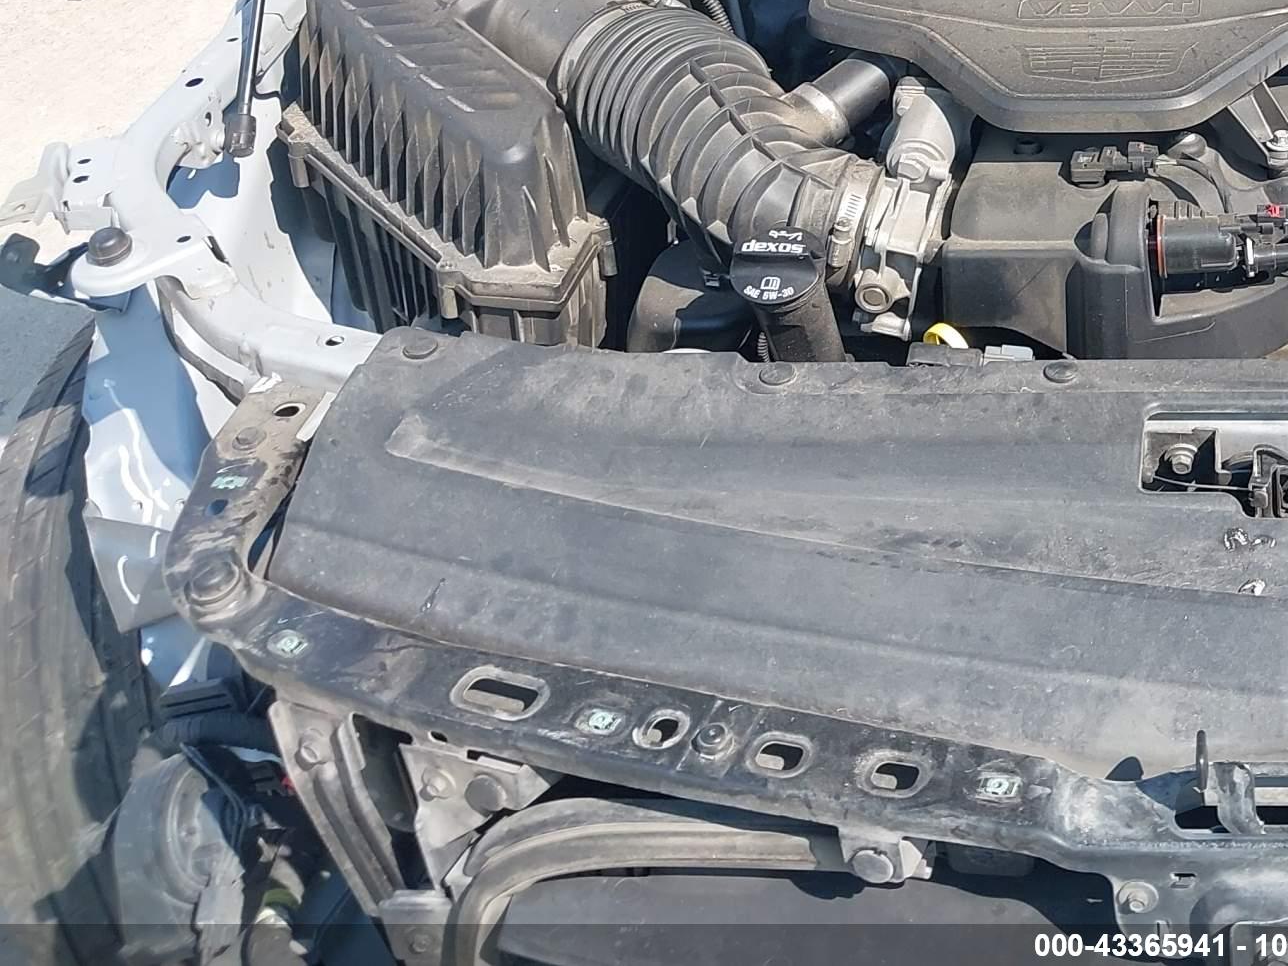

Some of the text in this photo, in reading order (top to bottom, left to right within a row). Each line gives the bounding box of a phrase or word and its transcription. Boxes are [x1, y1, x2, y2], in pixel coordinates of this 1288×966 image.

[741, 239, 806, 254] dexos
[743, 285, 795, 300] SAE 5W-30
